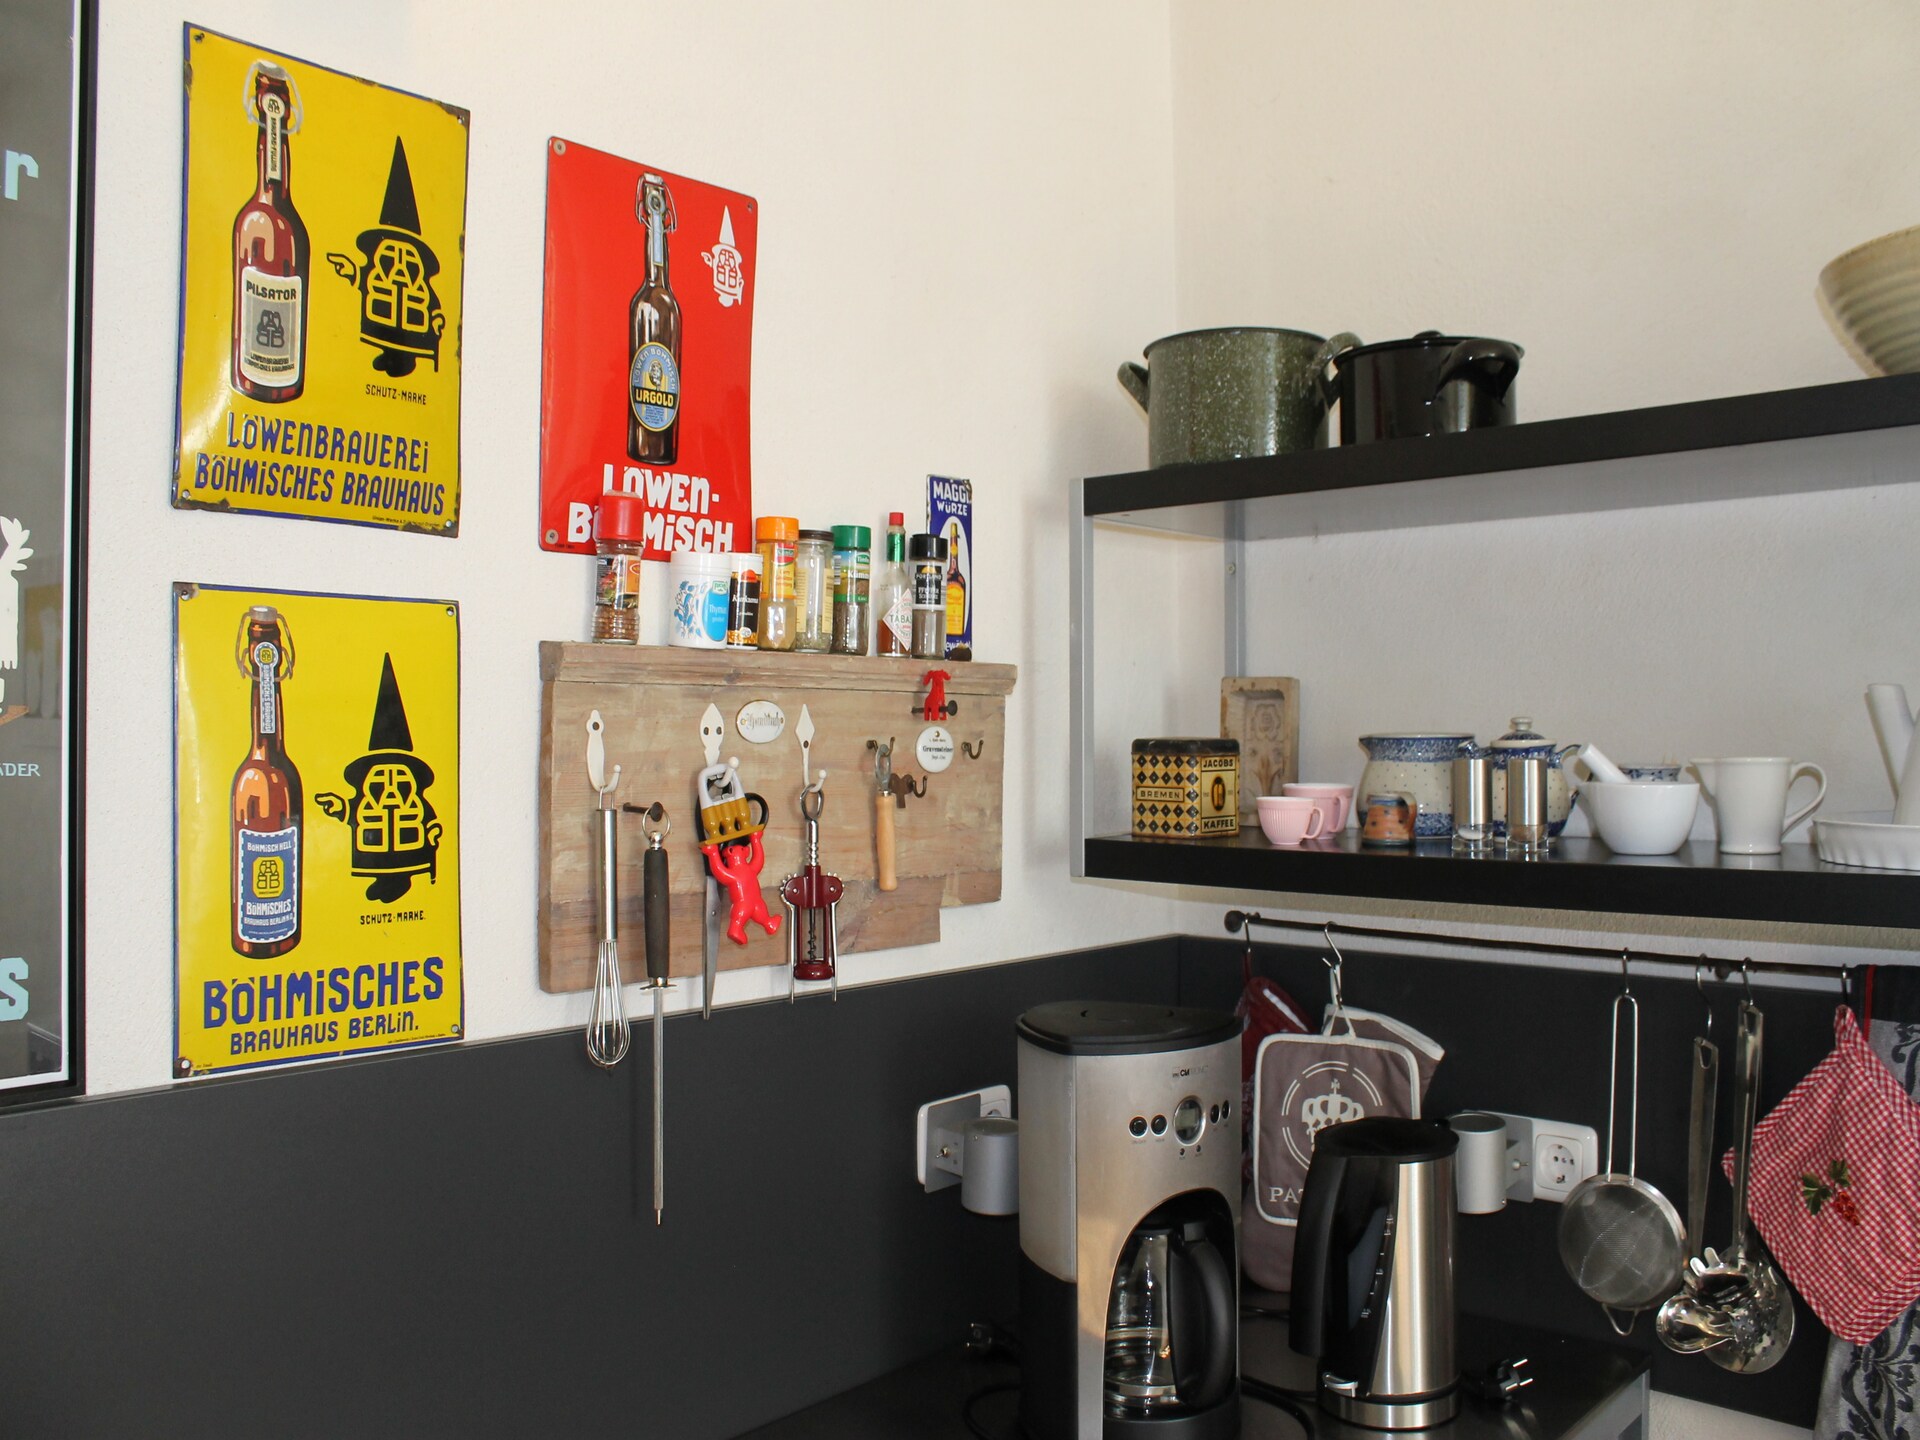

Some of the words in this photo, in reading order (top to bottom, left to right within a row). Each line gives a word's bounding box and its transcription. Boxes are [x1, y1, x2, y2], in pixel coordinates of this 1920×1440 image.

[246, 280, 297, 300] PILSATOR
[366, 384, 427, 405] SCHUTZ-MARKE
[636, 389, 674, 407] URGOLD
[341, 472, 446, 515] BRAUHAUS
[937, 500, 968, 516] WÜRZE
[567, 501, 734, 553] BMISCH
[1203, 759, 1233, 768] JACOBS
[1140, 790, 1180, 799] BREMEN
[1203, 819, 1234, 830] KAFFEE
[230, 1021, 338, 1055] BRAUHAUS
[1269, 1186, 1304, 1204] PA
